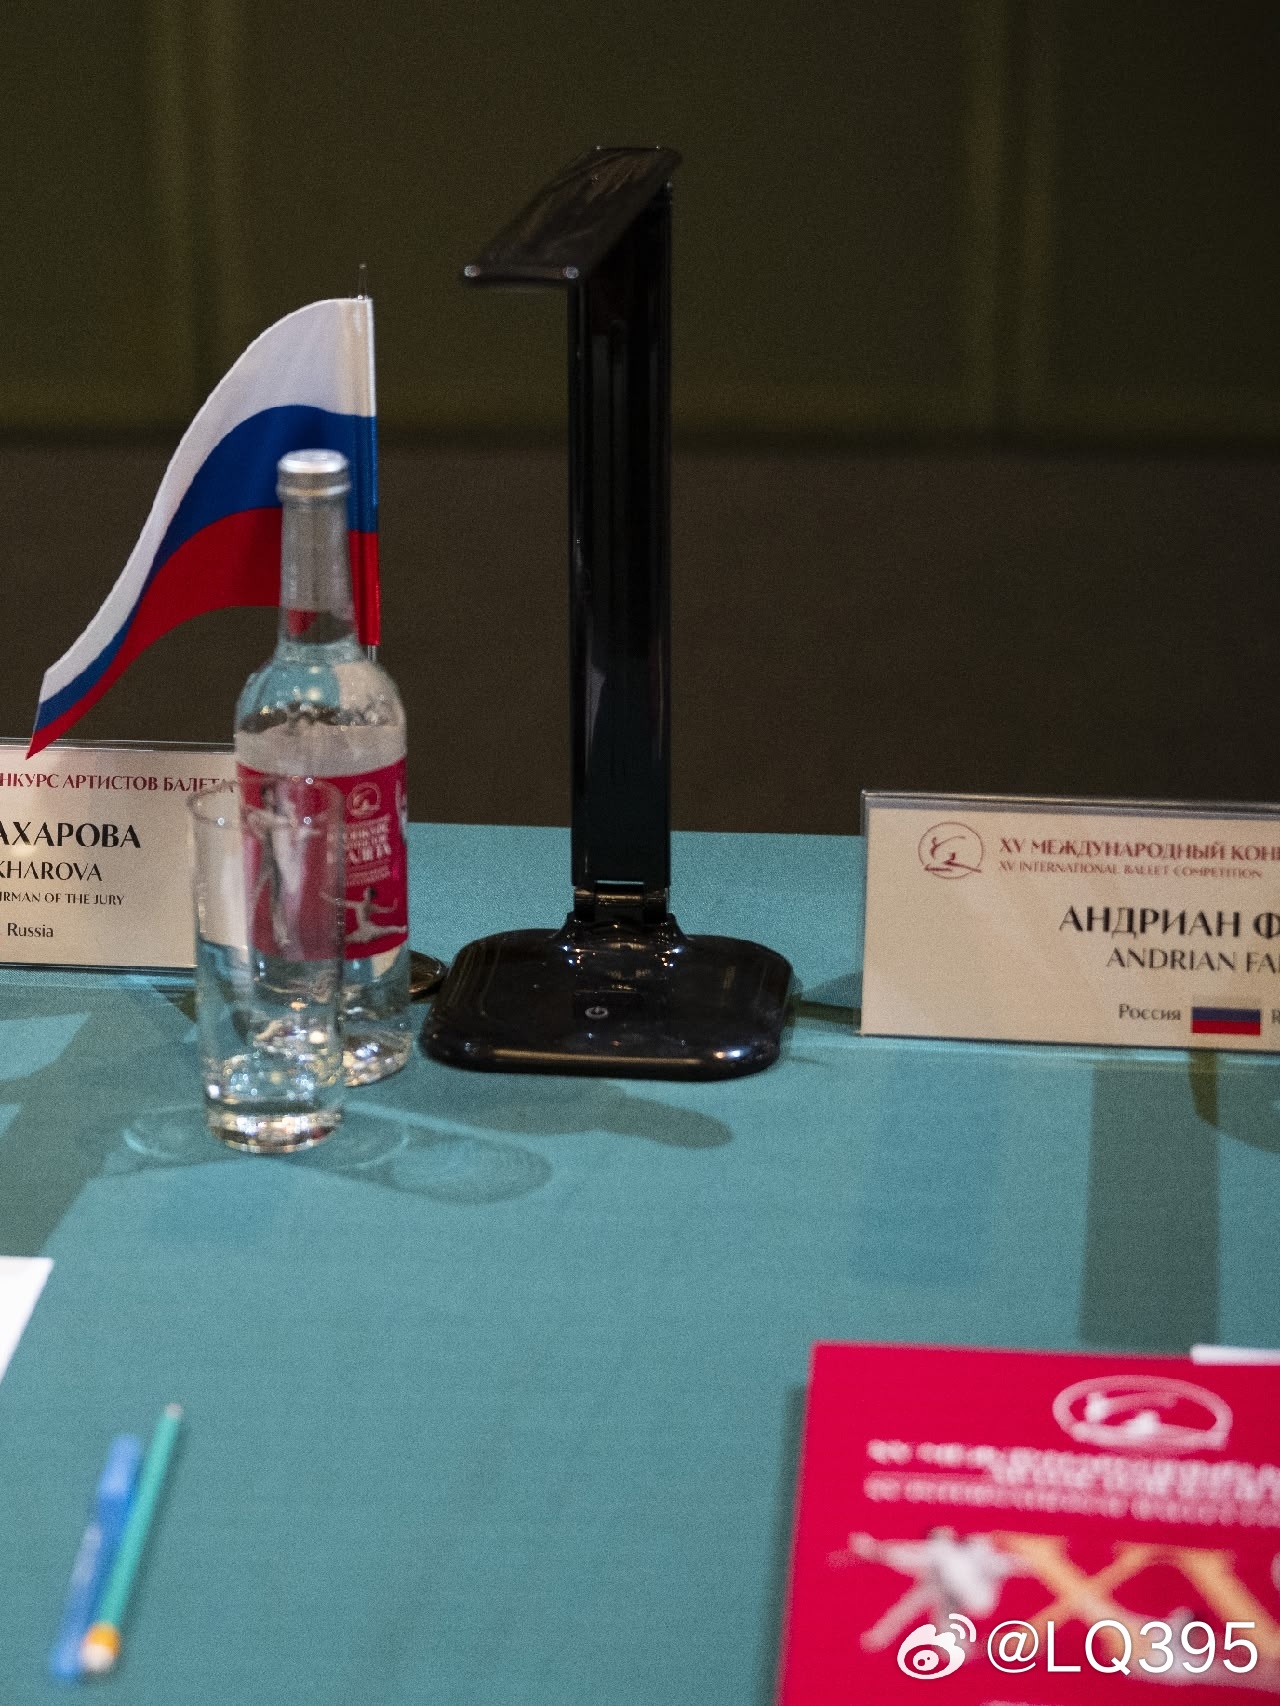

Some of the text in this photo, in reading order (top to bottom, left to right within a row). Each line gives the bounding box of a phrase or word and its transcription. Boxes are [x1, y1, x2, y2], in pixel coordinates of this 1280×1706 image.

[62, 774, 158, 791] АРТИСТОВ
[1031, 839, 1226, 861] МЕЖДУНАРОДНЫЙ
[1019, 861, 1119, 876] INTERNATIONAL
[1123, 864, 1168, 877] BALLET
[1173, 866, 1263, 879] COMPETITION
[44, 893, 62, 904] OF
[65, 893, 90, 905] THE
[93, 894, 124, 906] JURY
[7, 922, 54, 938] Russia
[1058, 905, 1241, 938] АНДРИАН
[1106, 947, 1280, 974] ANDRIAN FA
[1118, 1003, 1181, 1021] Россия
